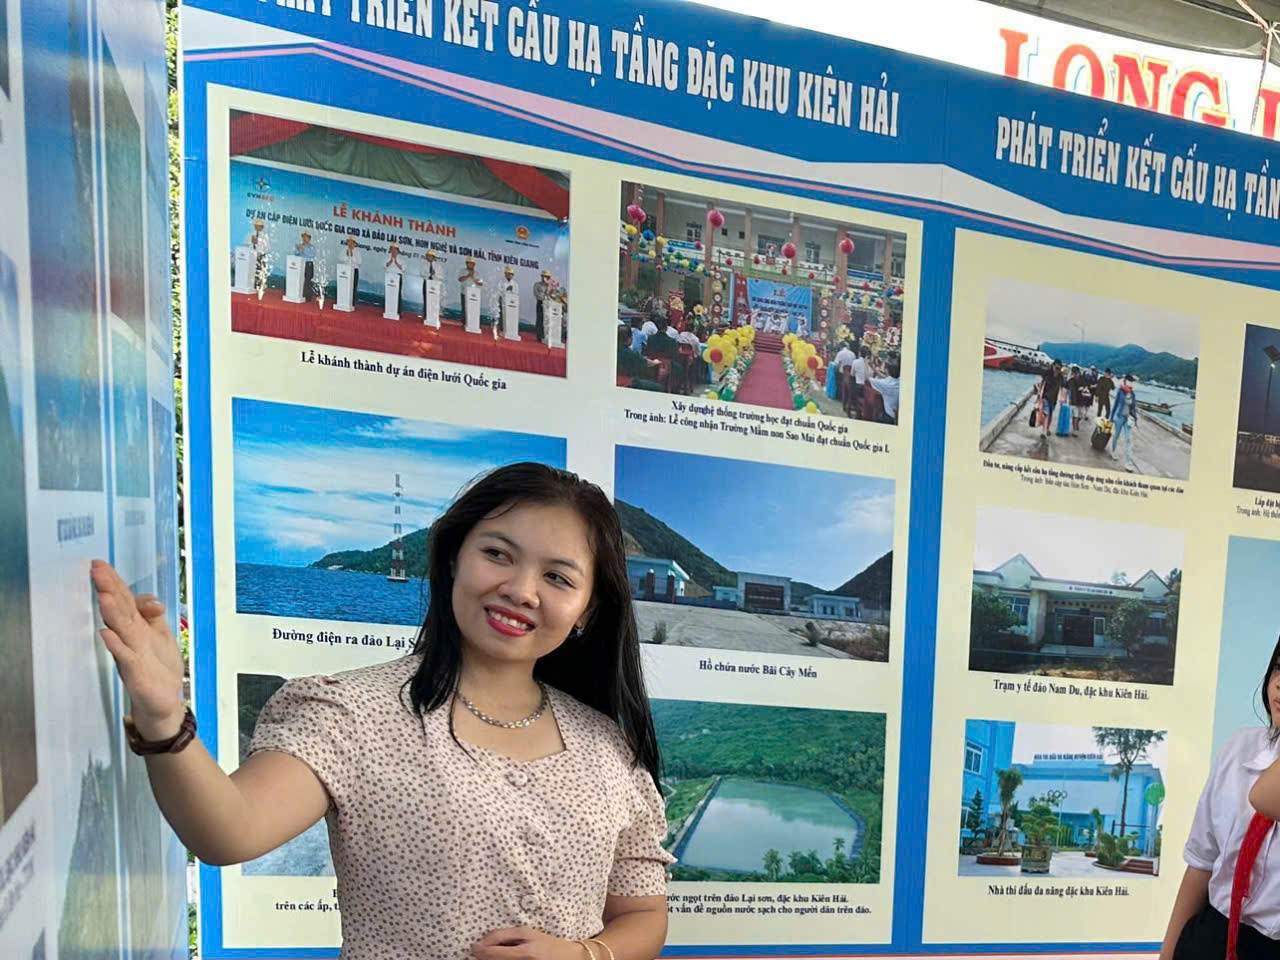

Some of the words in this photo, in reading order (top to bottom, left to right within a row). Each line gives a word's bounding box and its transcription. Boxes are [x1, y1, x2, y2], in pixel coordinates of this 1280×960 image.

[567, 19, 602, 88] HẠ
[611, 14, 680, 92] TẦNG
[686, 39, 735, 111] ĐẶC
[742, 58, 792, 115] KHU
[796, 64, 853, 129] KIÊN
[859, 71, 899, 138] HẢI
[995, 111, 1053, 170] PHÁT
[1059, 117, 1120, 186] TRIỂN
[1125, 131, 1166, 196] KẾT
[1170, 142, 1210, 204] CẤU
[1212, 164, 1238, 222] HẠ
[352, 206, 403, 229] KHÁNH
[408, 217, 457, 238] THÀNH
[301, 349, 316, 364] Lễ
[317, 352, 351, 369] khánh
[353, 358, 384, 373] thành
[386, 363, 401, 378] dự
[402, 365, 415, 378] án
[417, 368, 439, 382] điện
[441, 370, 461, 384] lưới
[463, 372, 490, 387] Quốc
[492, 378, 507, 390] gia
[272, 627, 313, 643] Đường
[316, 631, 342, 646] điện
[345, 636, 358, 646] ra
[361, 635, 383, 647] đảo
[386, 636, 405, 651] Lại
[699, 657, 713, 671] Hồ
[714, 661, 736, 673] chứa
[738, 663, 761, 675] nước
[762, 664, 777, 676] Bãi
[779, 665, 796, 679] Cây
[993, 679, 1015, 693] Trạm
[1016, 684, 1022, 693] y
[1023, 678, 1031, 693] tế
[1033, 681, 1047, 693] đảo
[1048, 682, 1067, 694] Nam
[1069, 684, 1083, 697] Du,
[1084, 684, 1097, 698] đặc
[1099, 685, 1113, 698] khu
[1115, 686, 1133, 699] Kiên
[1134, 687, 1149, 700] Hải.
[682, 893, 701, 905] ngọt
[703, 893, 721, 903] trên
[723, 893, 739, 903] đảo
[742, 893, 756, 905] Lại
[757, 894, 775, 904] sơn,
[777, 893, 791, 905] đặc
[792, 893, 809, 903] khu
[811, 893, 831, 903] Kiên
[832, 893, 849, 904] Hải.
[988, 884, 1004, 896] Nhà
[1005, 885, 1017, 896] thi
[1018, 882, 1033, 896] đấu
[1034, 885, 1044, 896] đa
[1045, 886, 1064, 898] năng
[1065, 885, 1079, 898] đặc
[1080, 885, 1094, 897] khu
[1096, 885, 1114, 897] Kiên
[1115, 886, 1130, 897] Hải.
[275, 900, 296, 911] trên
[298, 900, 315, 911] các
[317, 899, 333, 913] ấp,
[676, 902, 692, 914] vấn
[694, 902, 705, 914] đề
[706, 903, 733, 916] nguồn
[734, 905, 755, 914] nước
[757, 904, 776, 917] sạch
[777, 904, 793, 914] cho
[794, 905, 818, 917] người
[819, 903, 835, 914] dân
[837, 905, 853, 914] trên
[855, 904, 872, 915] đảo.
